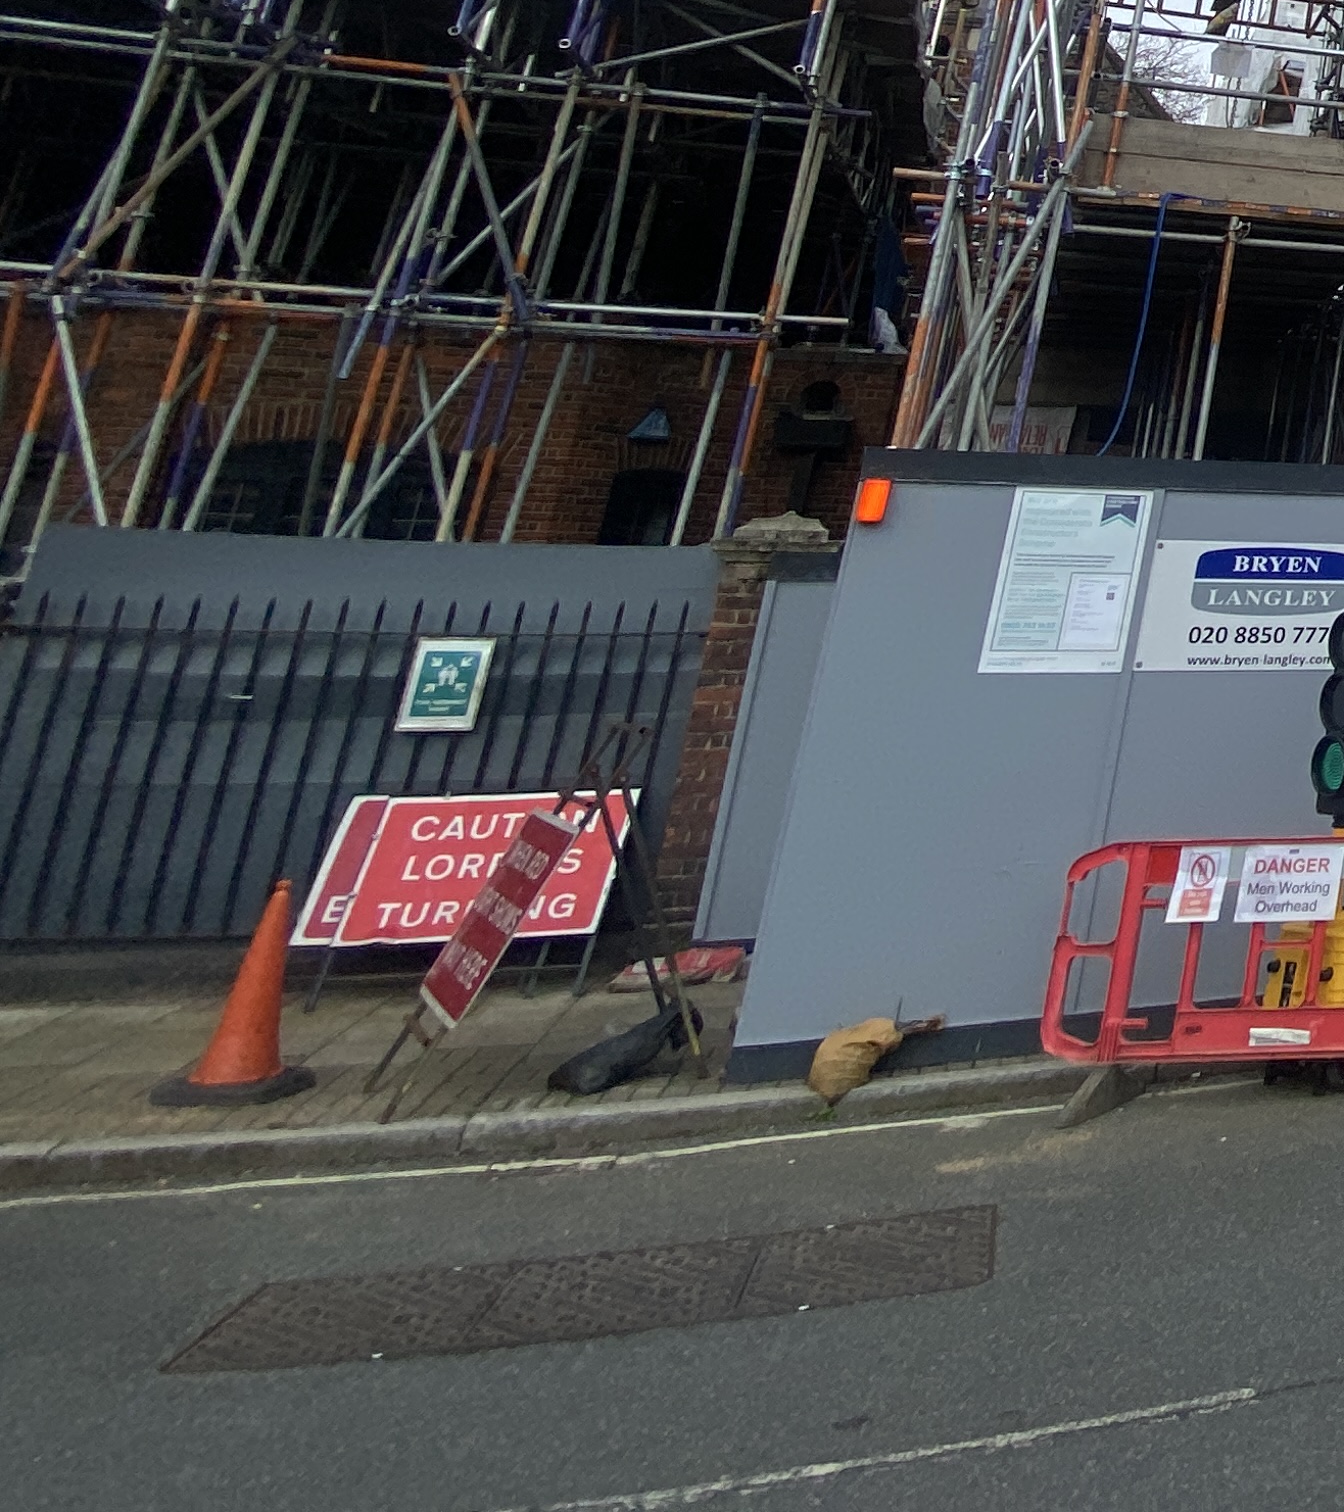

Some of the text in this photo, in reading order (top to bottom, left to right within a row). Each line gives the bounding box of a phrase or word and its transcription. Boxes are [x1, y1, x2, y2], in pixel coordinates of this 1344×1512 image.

[1233, 554, 1323, 573] BRYEN
[1207, 588, 1337, 607] LANGLEY
[1188, 626, 1330, 644] 020 8850 777
[411, 808, 602, 842] CAUTN
[401, 848, 582, 881] LORS
[1254, 858, 1331, 875] DANGER
[1246, 881, 1330, 896] Men Working
[377, 893, 577, 929] TURNG
[1254, 900, 1318, 913] Overhead
